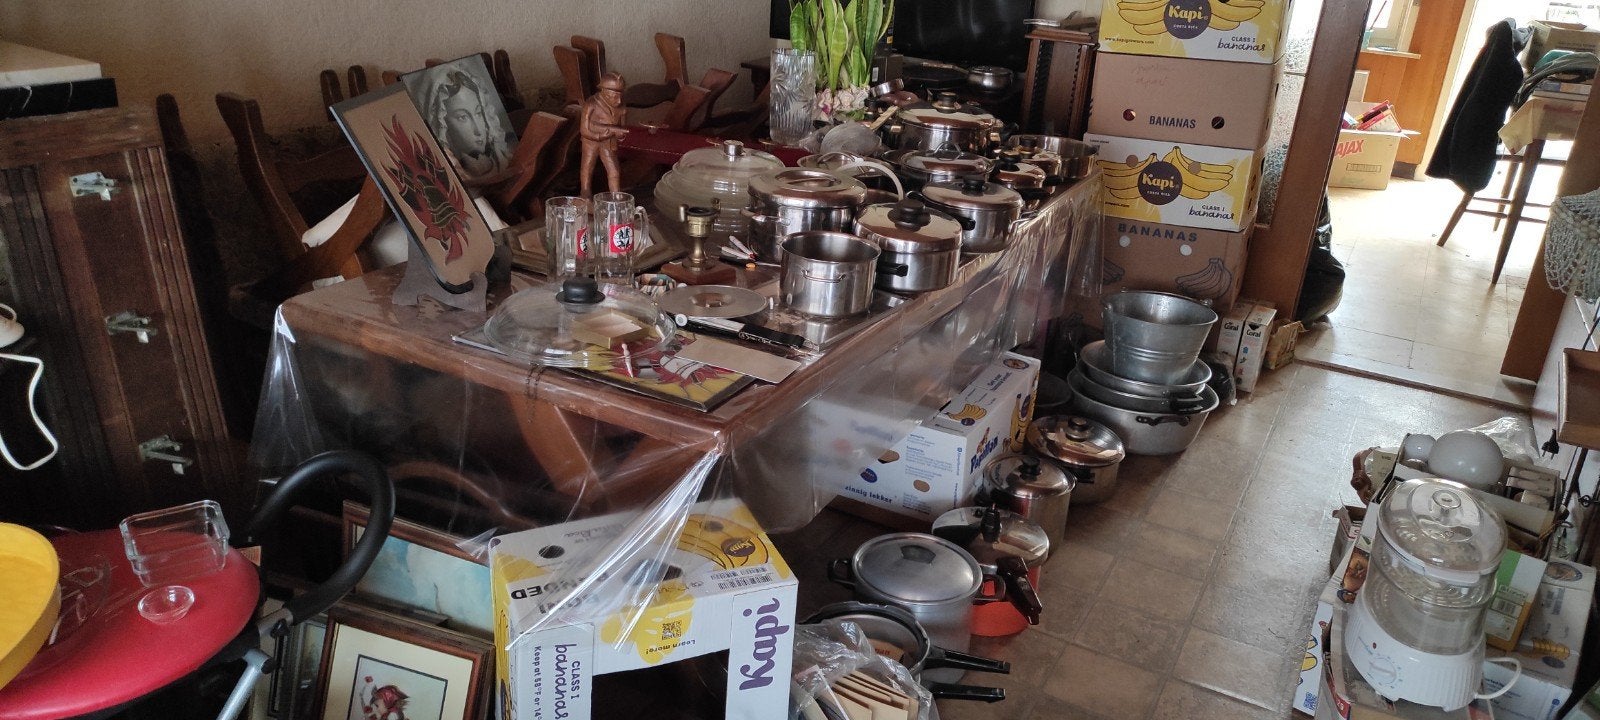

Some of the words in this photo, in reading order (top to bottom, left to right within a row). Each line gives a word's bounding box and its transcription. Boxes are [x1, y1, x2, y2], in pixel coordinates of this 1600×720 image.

[1168, 4, 1204, 23] Kapi
[1217, 38, 1266, 52] bananas
[1149, 115, 1196, 129] BANANAS
[1336, 140, 1364, 157] AJAX
[1142, 172, 1176, 191] Kapi
[1188, 205, 1235, 220] bananas
[1201, 204, 1220, 212] CLASS
[1117, 223, 1198, 242] BANANAS
[1224, 321, 1239, 331] Coral
[1246, 329, 1261, 338] Coral
[730, 538, 753, 552] Kapi
[646, 644, 671, 655] more!
[673, 639, 696, 648] Learn
[739, 597, 790, 691] Kapi
[532, 645, 542, 667] Keep
[534, 667, 541, 676] at
[570, 660, 581, 692] CLASS
[555, 643, 577, 720] bananas
[534, 697, 541, 706] or
